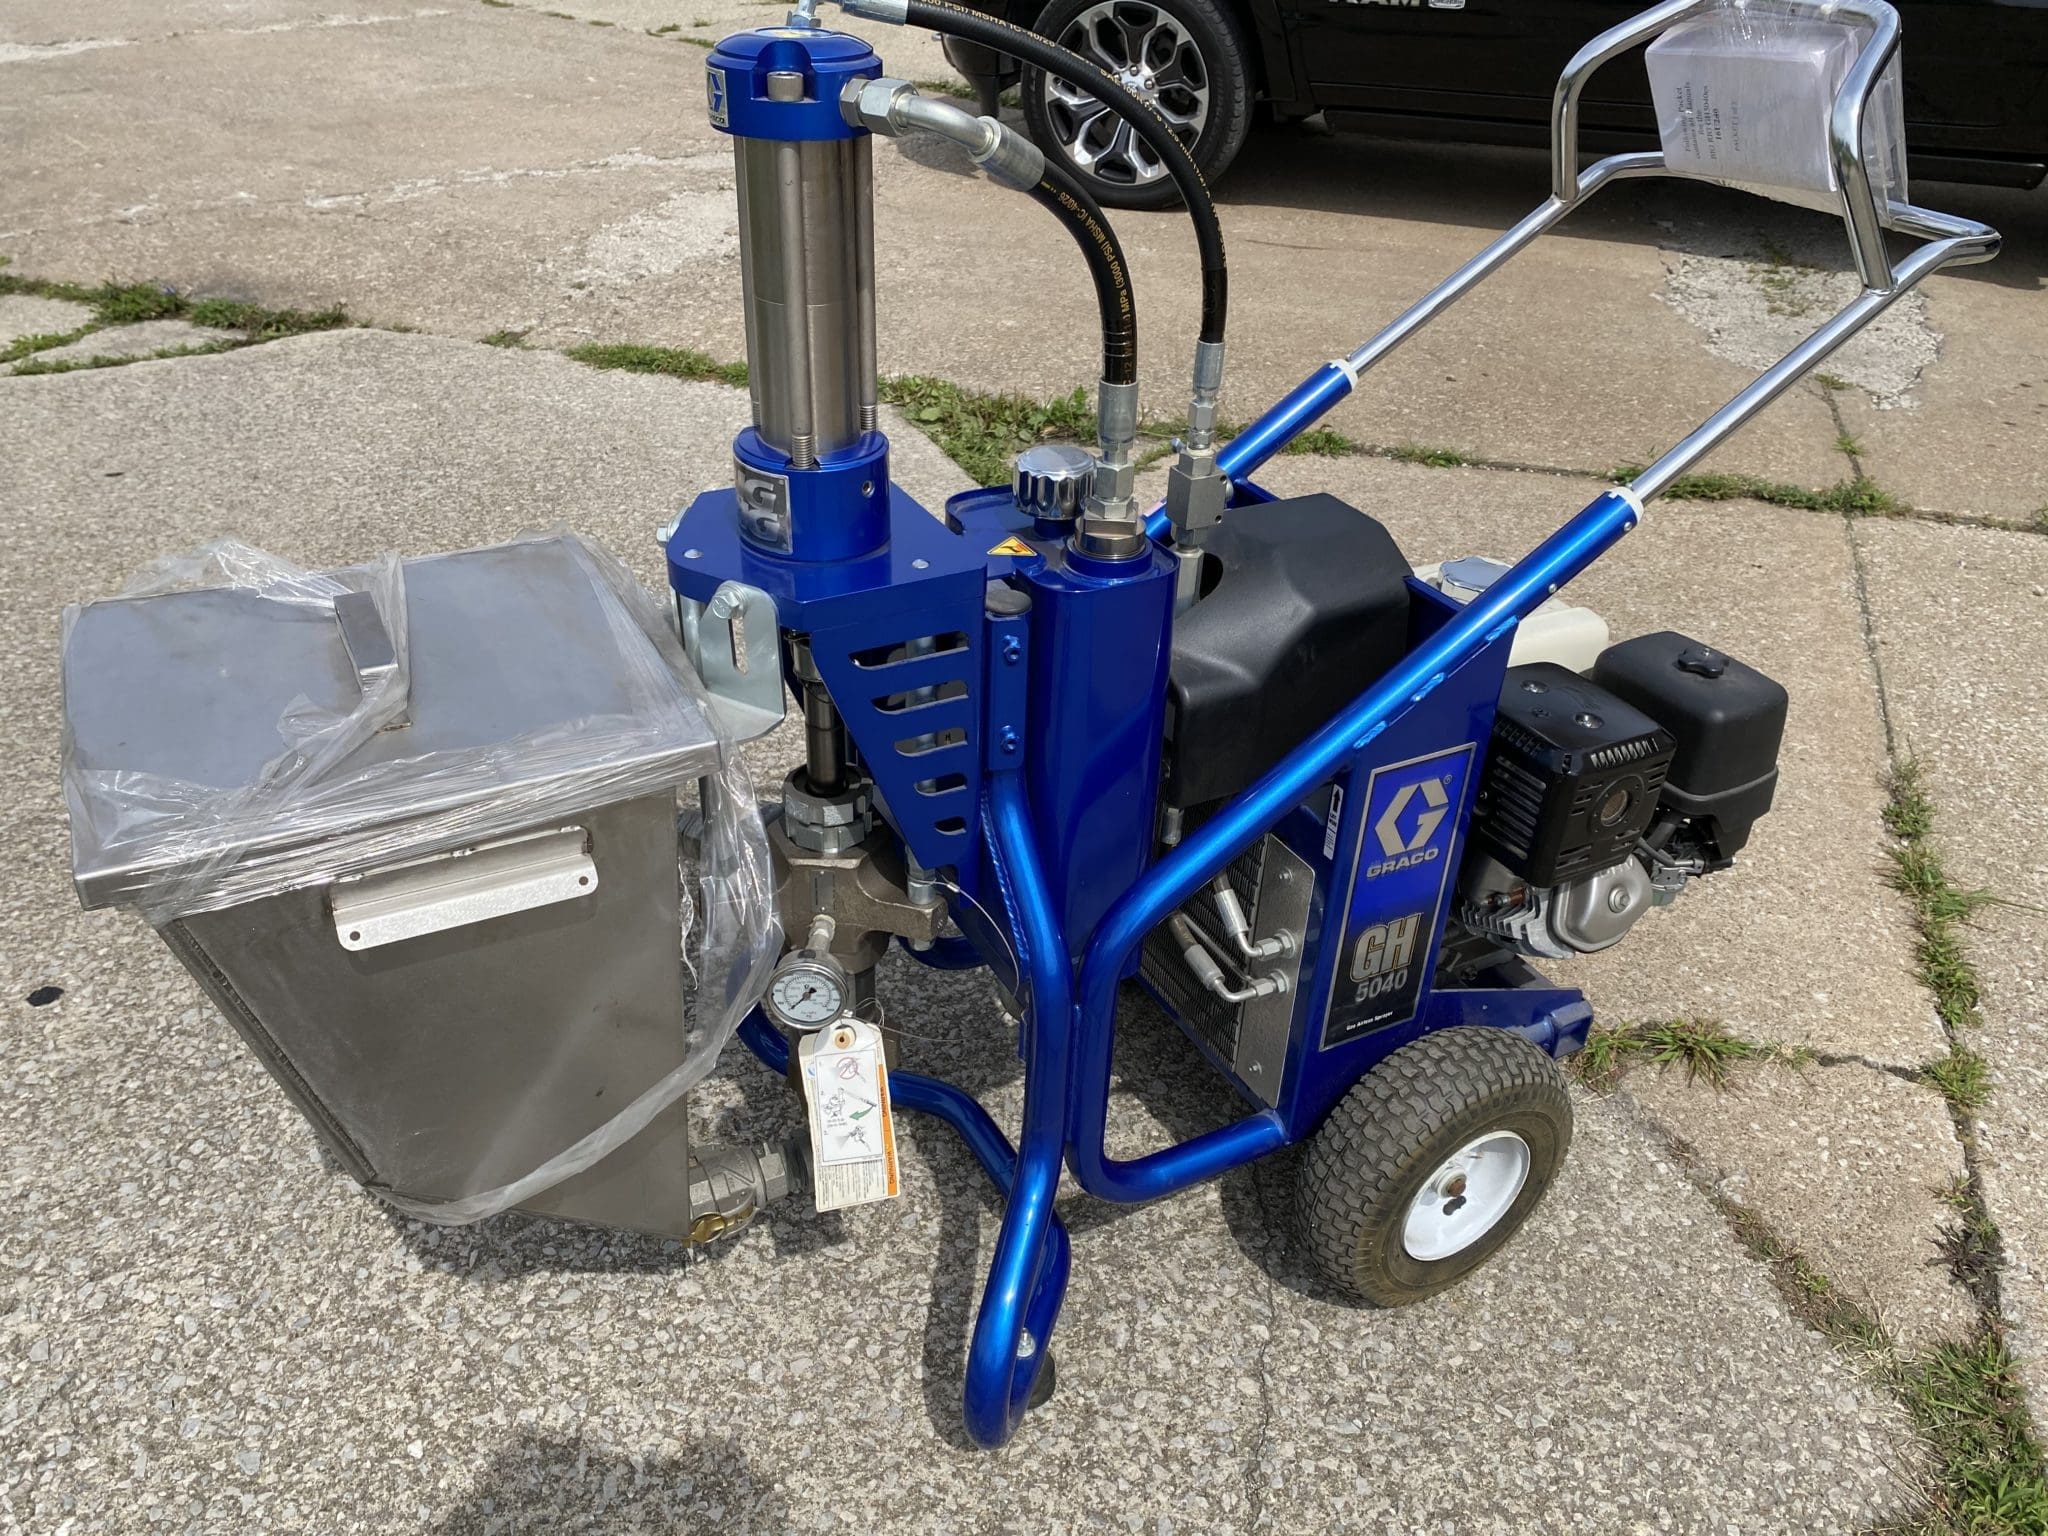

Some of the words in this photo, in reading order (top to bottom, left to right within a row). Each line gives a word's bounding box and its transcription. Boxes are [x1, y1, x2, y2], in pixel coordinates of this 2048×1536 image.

[1676, 87, 1685, 113] Packet
[1085, 215, 1107, 244] MSHA
[1101, 241, 1116, 263] PSI)
[1109, 261, 1126, 288] (3000
[1366, 847, 1439, 879] GRACO
[1349, 912, 1421, 983] GH
[1355, 968, 1408, 1003] 5040
